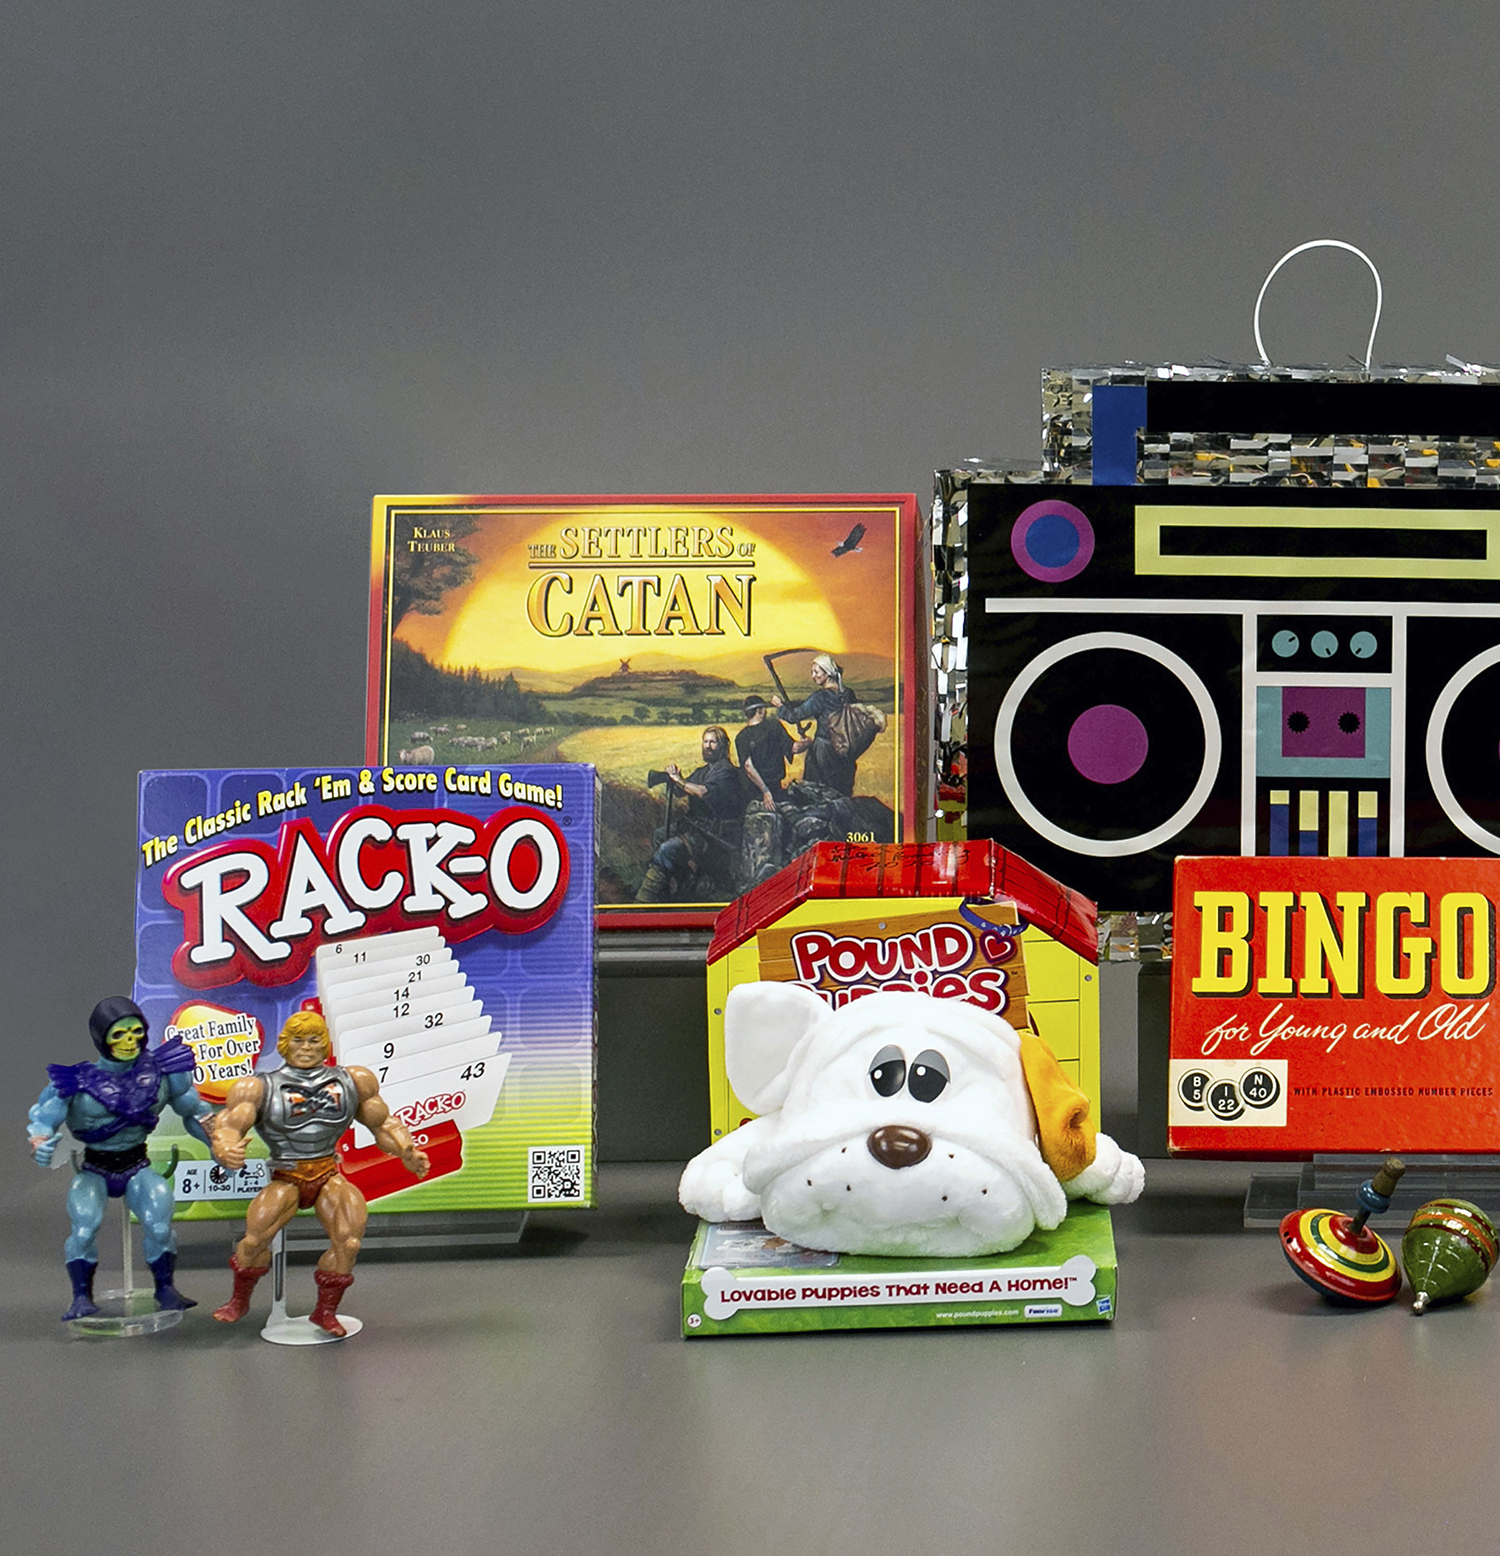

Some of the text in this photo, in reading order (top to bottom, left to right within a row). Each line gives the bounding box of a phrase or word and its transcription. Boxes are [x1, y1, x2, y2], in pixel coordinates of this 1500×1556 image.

[413, 527, 450, 539] KLAUS
[408, 540, 455, 552] TEUBER
[528, 526, 756, 559] THE SETTLERS OF
[526, 571, 757, 637] CATAN
[141, 834, 178, 867] The
[184, 800, 252, 846] Classic
[257, 781, 307, 818] Rack
[358, 769, 375, 795] &
[382, 766, 438, 793] Score
[445, 766, 491, 795] Card
[498, 772, 564, 810] Game!
[846, 831, 875, 843] 3061
[180, 816, 561, 964] RACK-O
[1192, 891, 1494, 998] BINGO
[353, 952, 367, 963] 11
[416, 954, 431, 966] 30
[793, 924, 972, 983] POUND
[408, 970, 423, 983] 21
[394, 987, 410, 1001] 14
[393, 1003, 410, 1018] 12
[208, 1014, 255, 1036] Family
[424, 1013, 444, 1029] 32
[1201, 1002, 1490, 1056] for Young and Old
[200, 1039, 259, 1060] For Over
[383, 1042, 395, 1059] 9
[208, 1059, 252, 1081] Years!
[379, 1066, 389, 1083] 7
[460, 1061, 485, 1081] 43
[1249, 1087, 1267, 1099] 40
[1294, 1087, 1494, 1097] WITH PLASTIC EMBOSSED NUMBER PIECES
[394, 1090, 467, 1128] RACK-O
[1218, 1099, 1235, 1111] 22
[208, 1184, 231, 1192] 10-30
[721, 1288, 797, 1303] Lovable
[885, 1282, 930, 1299] That
[935, 1280, 984, 1295] Need
[989, 1280, 1002, 1293] A
